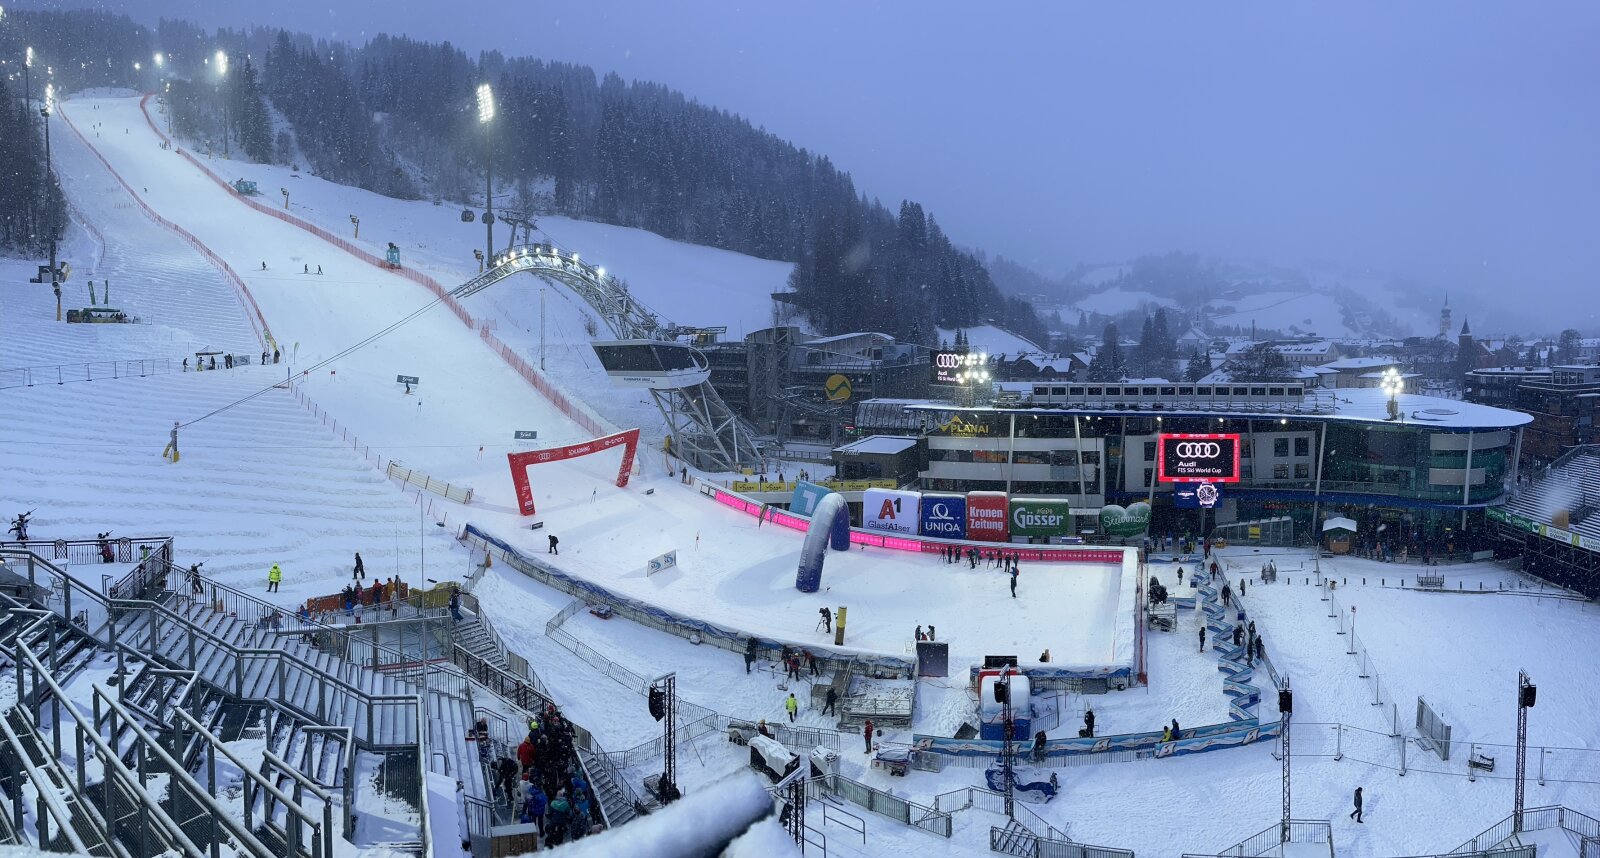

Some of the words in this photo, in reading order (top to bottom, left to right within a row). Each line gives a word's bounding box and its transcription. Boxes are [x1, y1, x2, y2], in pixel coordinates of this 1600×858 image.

[951, 424, 989, 434] PLANAI
[878, 497, 902, 520] A1
[970, 506, 1004, 519] Kronen
[1013, 507, 1064, 529] Gösser
[925, 522, 961, 532] UNIQA
[970, 519, 1004, 531] Zeitung
